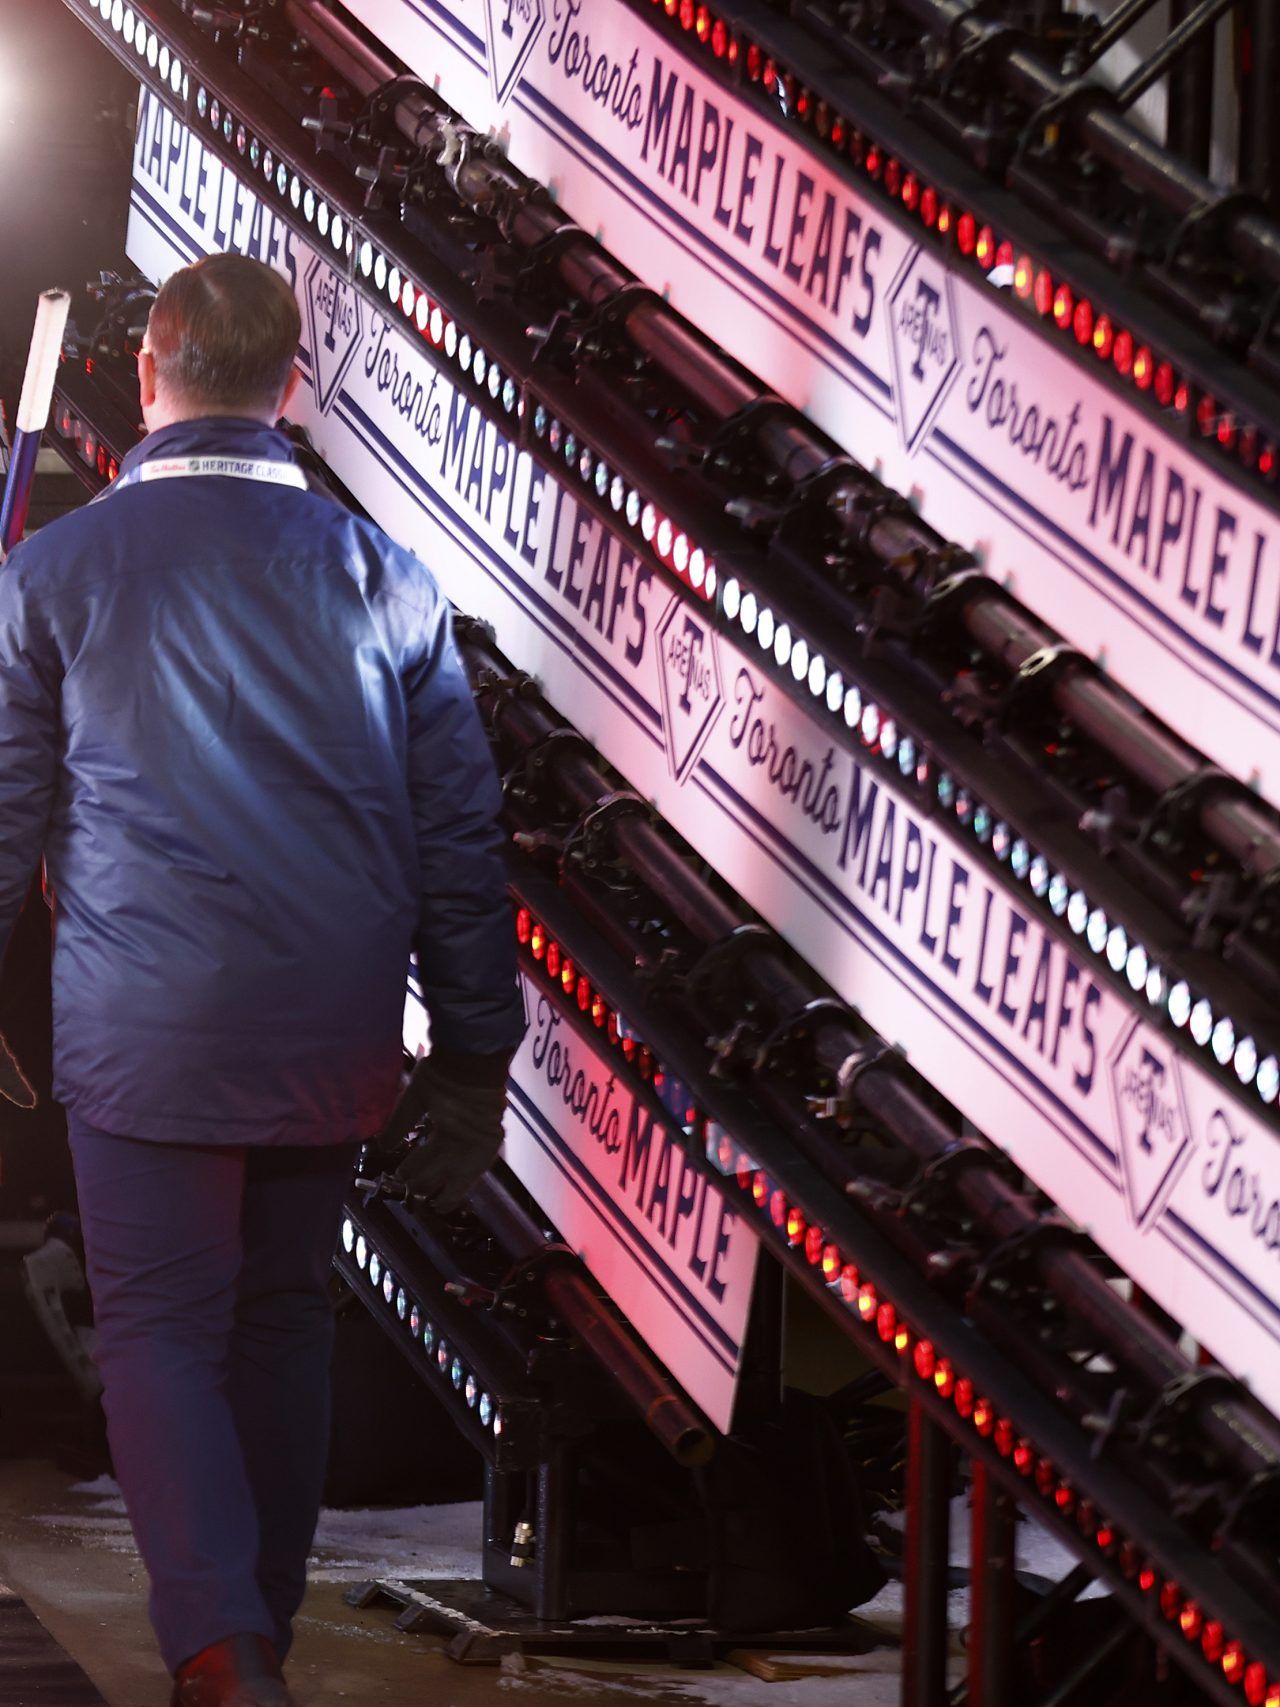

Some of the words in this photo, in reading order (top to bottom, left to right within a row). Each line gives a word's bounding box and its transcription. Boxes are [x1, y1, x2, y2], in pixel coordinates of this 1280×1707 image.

[315, 279, 353, 338] ARENAS
[548, 0, 643, 130] Toronto
[642, 57, 761, 246] MAPLE
[762, 154, 882, 337] LEAFS
[202, 460, 253, 474] HERITAGE
[365, 309, 442, 447] Toronto
[439, 390, 542, 567] MAPLE
[544, 470, 656, 666] LEAFS
[967, 326, 1089, 493] Toronto
[1087, 412, 1237, 627] MAPLE
[730, 667, 840, 835] Toronto
[837, 763, 969, 977] MAPLE
[972, 891, 1102, 1100] LEAFS
[533, 993, 621, 1153] Toronto
[618, 1105, 737, 1305] MAPLE
